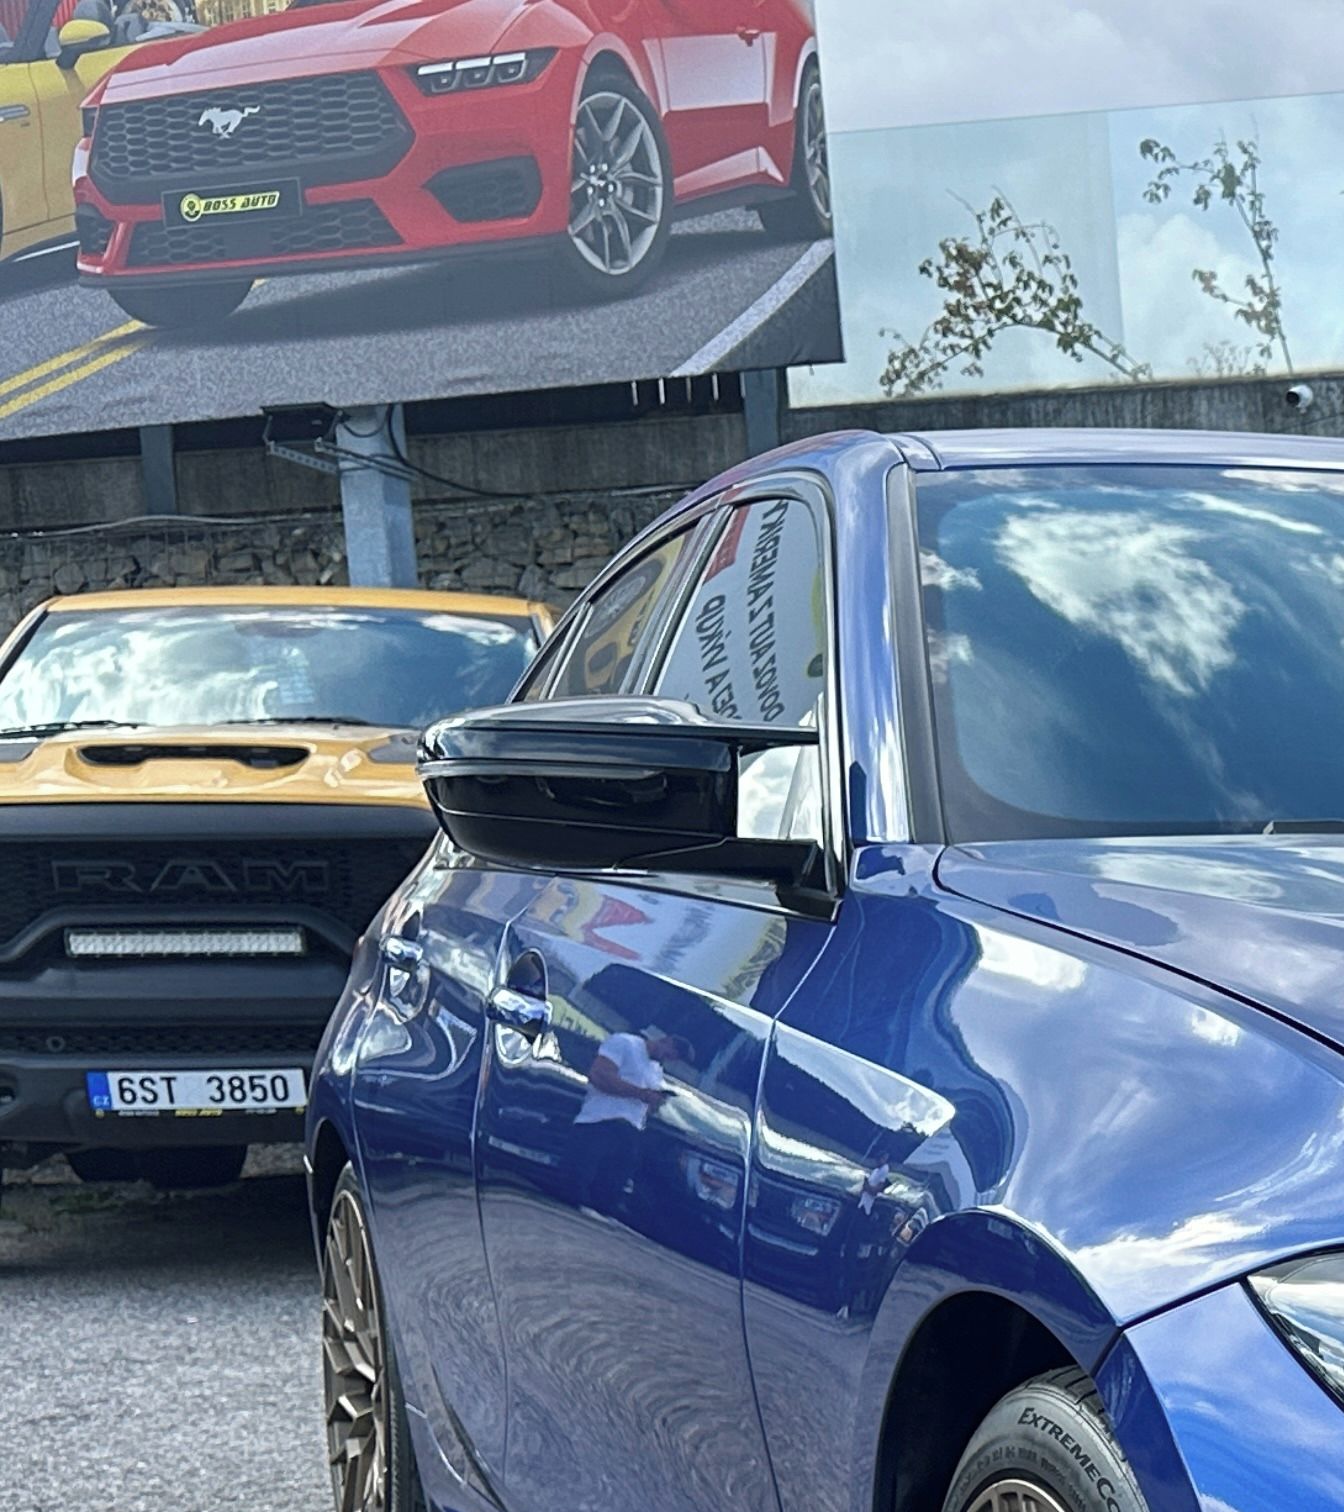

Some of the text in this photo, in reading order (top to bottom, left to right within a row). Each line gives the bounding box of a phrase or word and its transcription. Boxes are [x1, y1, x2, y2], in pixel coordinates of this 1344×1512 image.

[203, 194, 277, 212] BOSS AUTO
[50, 859, 330, 893] RAM
[117, 1075, 289, 1105] 6ST 3850
